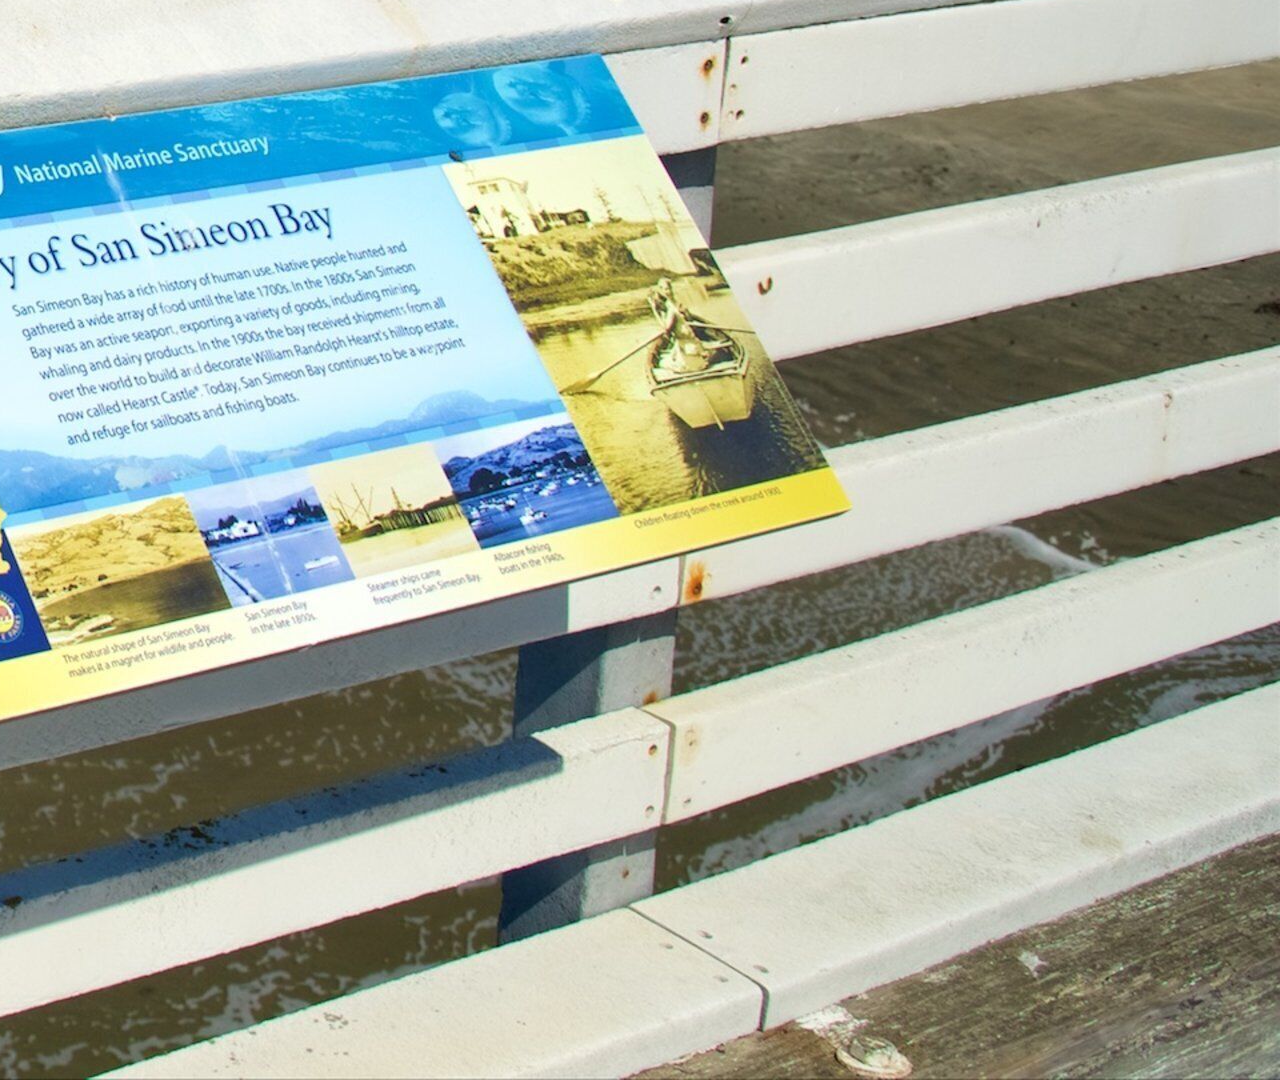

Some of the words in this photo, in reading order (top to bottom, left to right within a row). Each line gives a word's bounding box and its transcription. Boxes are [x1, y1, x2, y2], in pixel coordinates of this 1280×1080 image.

[13, 154, 102, 184] National
[100, 144, 175, 172] Marine
[172, 133, 271, 164] Sanctuary
[23, 235, 68, 274] of
[69, 230, 139, 267] San
[139, 212, 271, 256] Simeon
[268, 200, 336, 242] Bay
[11, 302, 36, 317] San
[35, 295, 82, 313] Simeon
[80, 291, 105, 307] Bay
[103, 288, 126, 301] has
[126, 288, 135, 298] a
[134, 281, 158, 296] rich
[157, 277, 198, 293] history
[197, 272, 211, 286] of
[209, 268, 252, 284] human
[251, 265, 275, 277] use.
[273, 258, 310, 273] Native
[309, 251, 348, 270] people
[345, 244, 386, 261] hunted
[385, 240, 408, 254] and
[20, 317, 76, 341] gathered
[76, 318, 85, 328] a
[84, 311, 115, 327] wide
[115, 308, 146, 323] array
[144, 302, 159, 317] of
[186, 294, 214, 310] until
[213, 291, 234, 305] the
[232, 288, 256, 301] late
[255, 282, 292, 297] 1700s.
[290, 280, 304, 291] In
[302, 277, 324, 289] the
[323, 271, 356, 286] 1800s
[353, 267, 376, 281] San
[374, 261, 416, 277] Simeon
[28, 344, 53, 361] Bay
[52, 342, 78, 355] was
[78, 339, 95, 351] an
[94, 332, 131, 348] active
[178, 315, 235, 335] exporting
[233, 313, 242, 323] a
[241, 307, 281, 323] variety
[279, 301, 293, 315] of
[292, 296, 332, 316] goods,
[329, 288, 382, 307] including
[379, 282, 421, 299] mining,
[37, 361, 89, 382] whaling
[87, 356, 112, 371] and
[111, 352, 143, 368] dairy
[142, 342, 198, 364] products.
[196, 339, 211, 351] In
[209, 335, 231, 349] the
[230, 329, 265, 345] 1900s
[263, 326, 285, 340] the
[283, 323, 307, 337] bay
[305, 313, 352, 332] received
[351, 305, 407, 325] shipments
[405, 300, 433, 313] from
[431, 296, 446, 309] all
[47, 388, 75, 402] over
[75, 382, 98, 396] the
[97, 375, 133, 392] world
[132, 374, 148, 386] to
[146, 366, 179, 383] build
[178, 362, 203, 378] and
[202, 354, 253, 373] decorate
[250, 347, 294, 364] William
[292, 336, 348, 357] Randolph
[345, 329, 389, 346] Hearst's
[387, 323, 424, 339] hilltop
[423, 318, 459, 333] estate,
[56, 410, 85, 423] now
[84, 400, 122, 418] called
[120, 394, 161, 411] Hearst
[203, 379, 241, 397] Today,
[239, 374, 263, 389] San
[261, 367, 306, 385] Simeon
[304, 362, 327, 378] Bay
[326, 354, 380, 372] continues
[378, 351, 393, 362] to
[391, 347, 409, 360] be
[408, 347, 417, 357] a
[65, 428, 91, 445] and
[90, 422, 132, 442] refuge
[130, 418, 149, 432] for
[149, 409, 201, 429] sailboats
[200, 403, 225, 419] and
[223, 397, 266, 416] fishing
[263, 391, 299, 407] boats.
[493, 548, 525, 561] Albacore
[524, 542, 552, 555] fishing
[498, 563, 521, 575] boats
[518, 559, 530, 570] in
[527, 558, 542, 567] the
[366, 578, 399, 592] Steamer
[399, 573, 421, 585] ships
[419, 568, 441, 580] came
[372, 589, 413, 605] frequently
[412, 587, 422, 595] to
[421, 583, 437, 593] San
[436, 576, 466, 590] Simeon
[244, 611, 261, 622] San
[260, 603, 292, 618] Simeon
[291, 600, 308, 611] Bay
[62, 652, 79, 664] The
[79, 646, 110, 660] natural
[110, 640, 136, 654] shape
[136, 637, 146, 647] of
[146, 634, 163, 644] San
[162, 627, 195, 640] Simeon
[194, 623, 210, 634] Bay
[67, 664, 97, 678] makes
[94, 660, 105, 672] it
[110, 653, 145, 669] magnet
[143, 649, 156, 660] for
[187, 638, 205, 650] and
